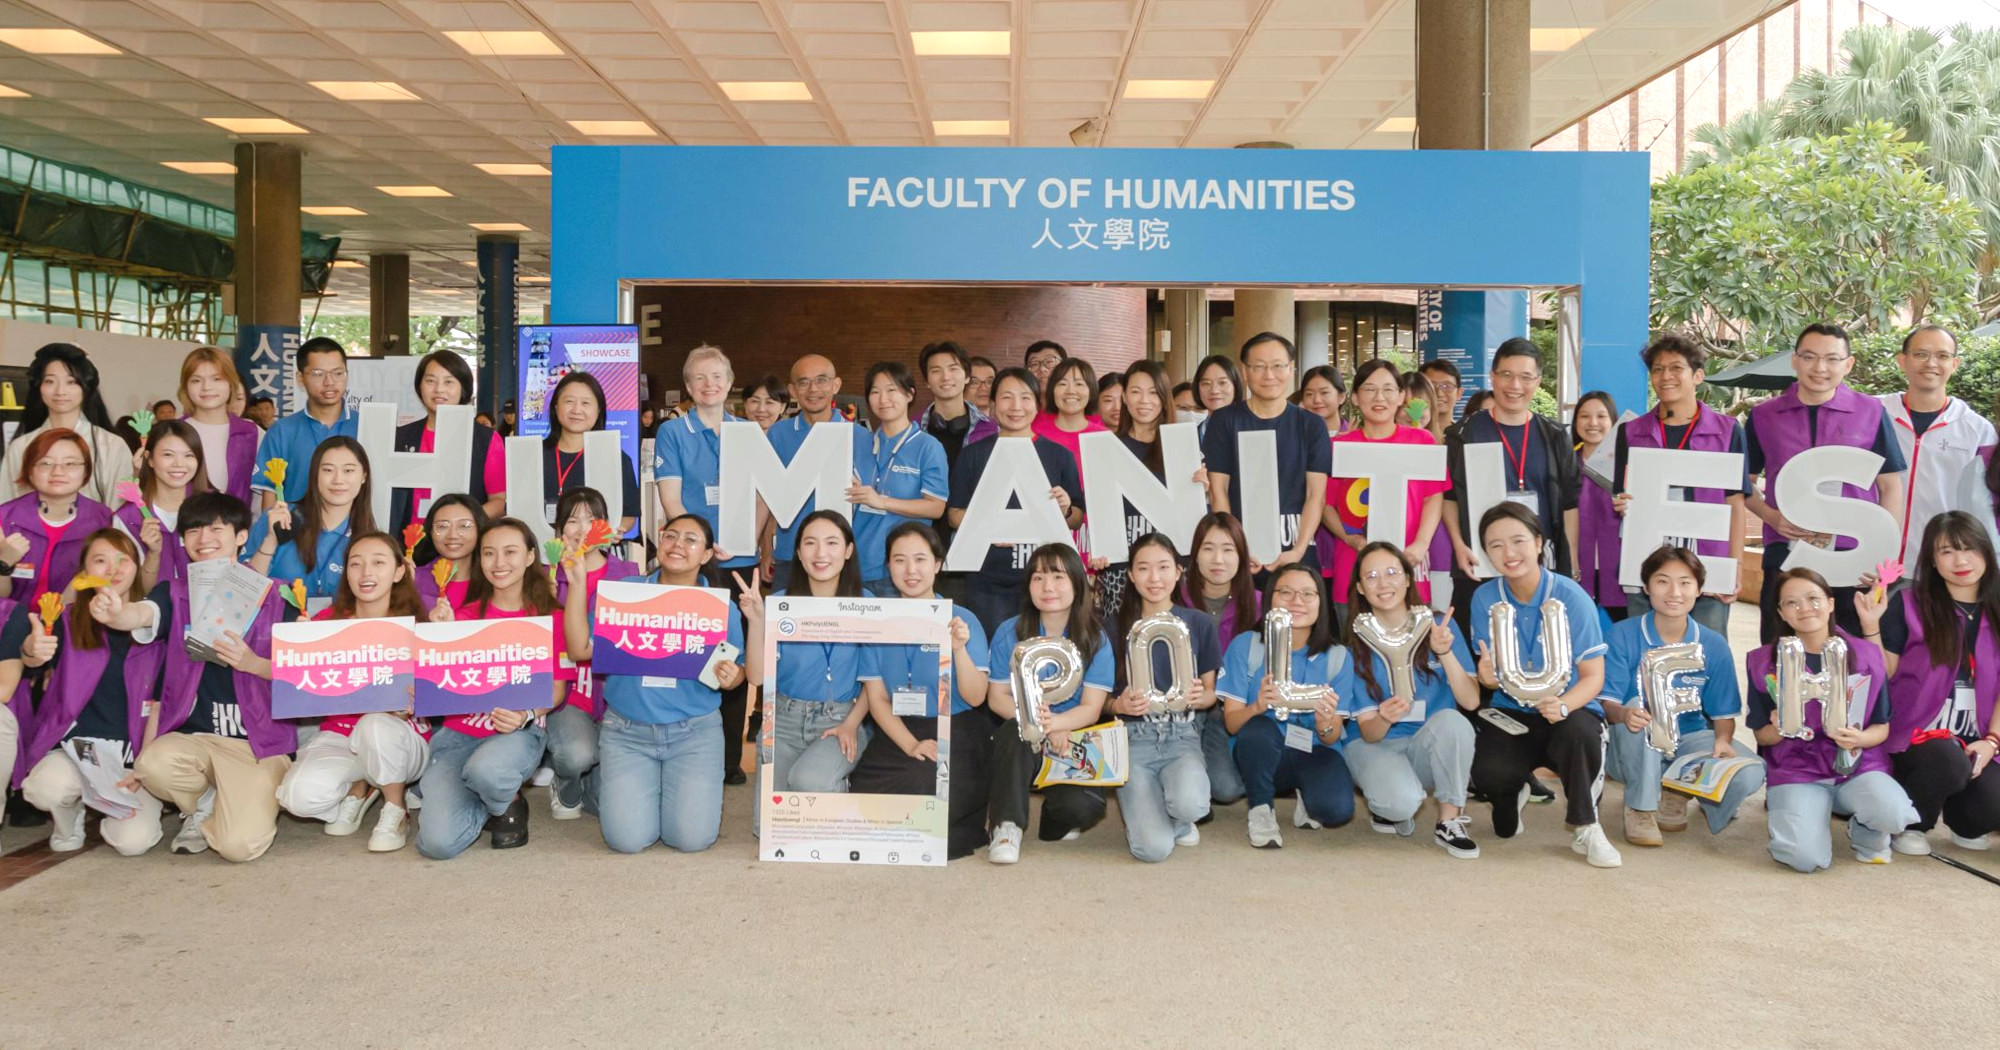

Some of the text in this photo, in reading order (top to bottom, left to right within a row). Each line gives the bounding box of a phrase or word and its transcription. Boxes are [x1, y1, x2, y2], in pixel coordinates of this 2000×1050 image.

[847, 177, 1355, 211] FACULTY OF HUMANITIES
[1032, 217, 1171, 251] 人文學院
[1429, 310, 1442, 332] OF
[580, 348, 631, 358] SHOWCASE
[283, 333, 299, 417] HUMANI
[598, 606, 724, 633] Humanities
[837, 602, 882, 615] Instagram
[276, 643, 412, 668] Humanities
[418, 642, 549, 668] Humanities
[614, 630, 706, 655] 人文學院
[295, 665, 394, 691] 人文學院
[436, 664, 532, 690] 人文學院
